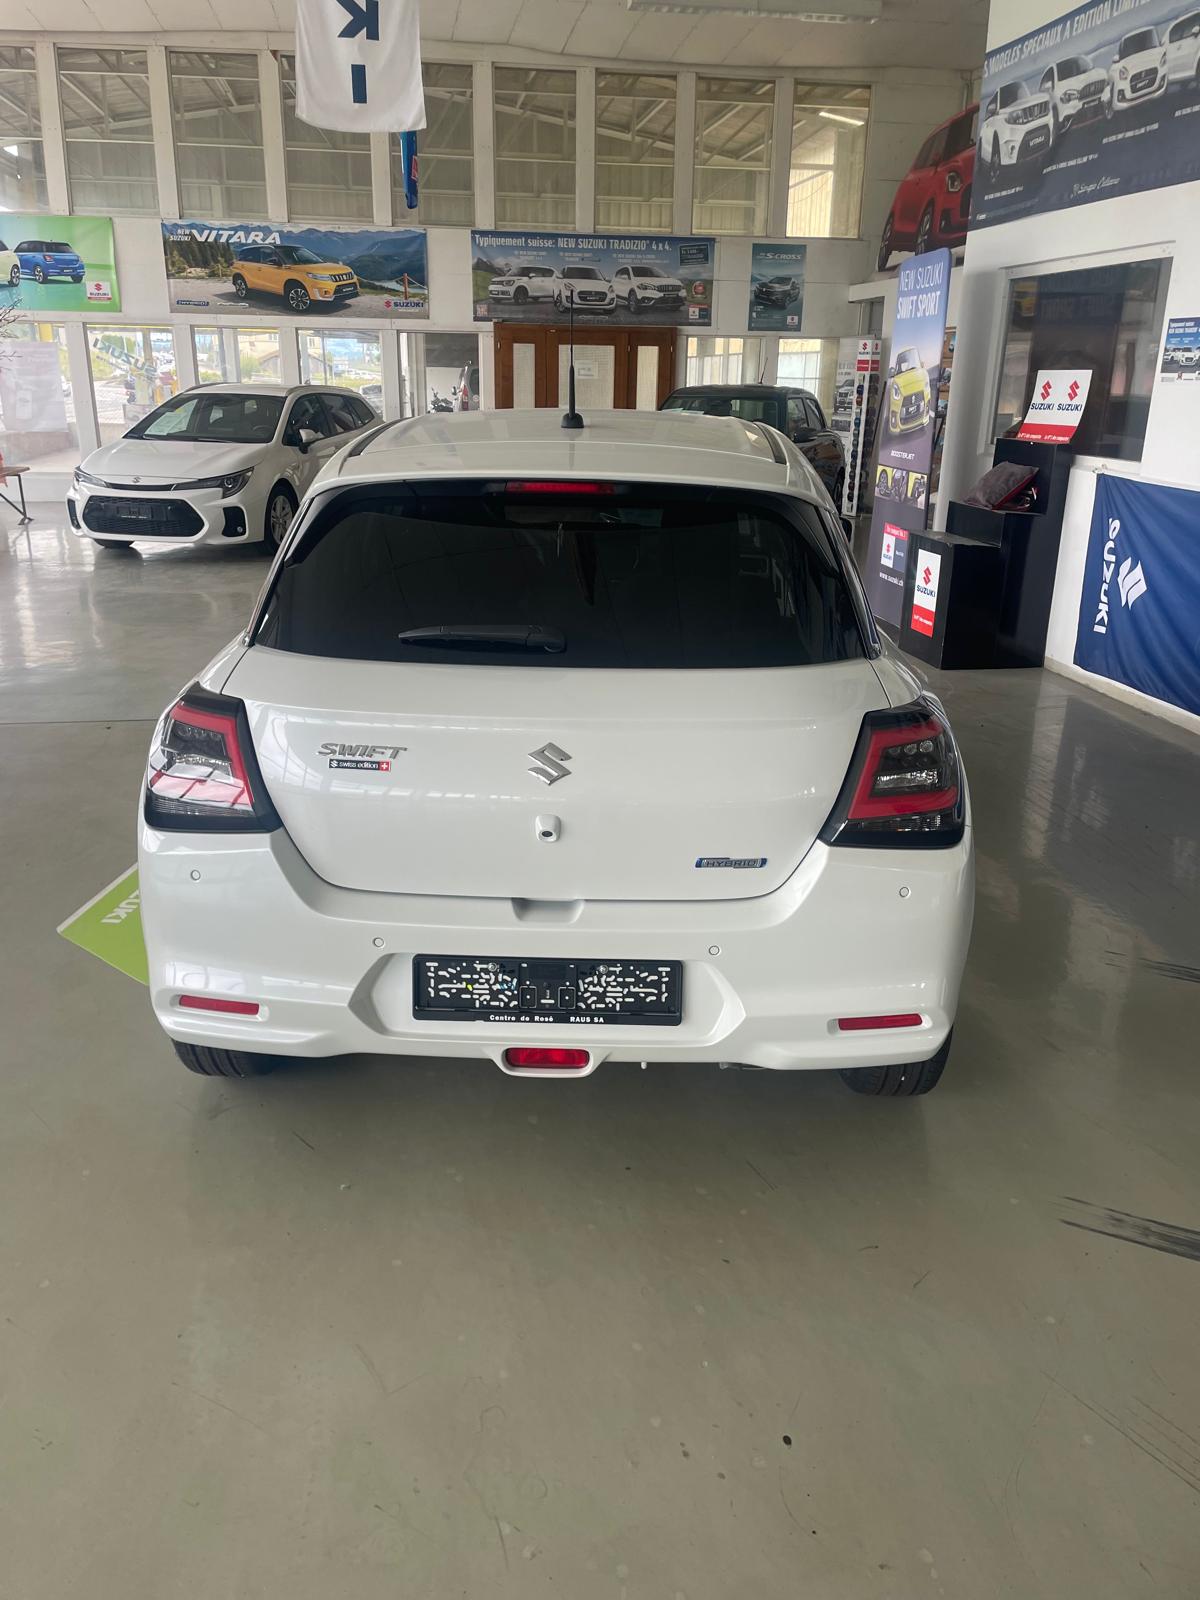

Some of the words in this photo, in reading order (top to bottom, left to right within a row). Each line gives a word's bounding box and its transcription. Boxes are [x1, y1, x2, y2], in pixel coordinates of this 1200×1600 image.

[989, 44, 1022, 76] MODELES
[1021, 23, 1063, 60] SPECIAUX
[1072, 0, 1111, 36] EDITION
[191, 228, 281, 245] VITARA
[475, 234, 526, 248] Typiquement
[527, 236, 555, 248] suisse:
[557, 237, 576, 248] NEW
[578, 238, 607, 249] SUZUKI
[900, 270, 915, 291] NEW
[916, 261, 944, 288] SUZUKI
[393, 301, 424, 309] SUZUKI
[897, 296, 917, 320] SWIFT
[916, 291, 941, 318] SPORT
[1030, 402, 1055, 411] SUZUKI
[1056, 403, 1083, 412] SUZUKI
[916, 584, 936, 598] SUZUKI
[318, 742, 408, 760] SWIFT
[706, 860, 757, 868] HYBRID
